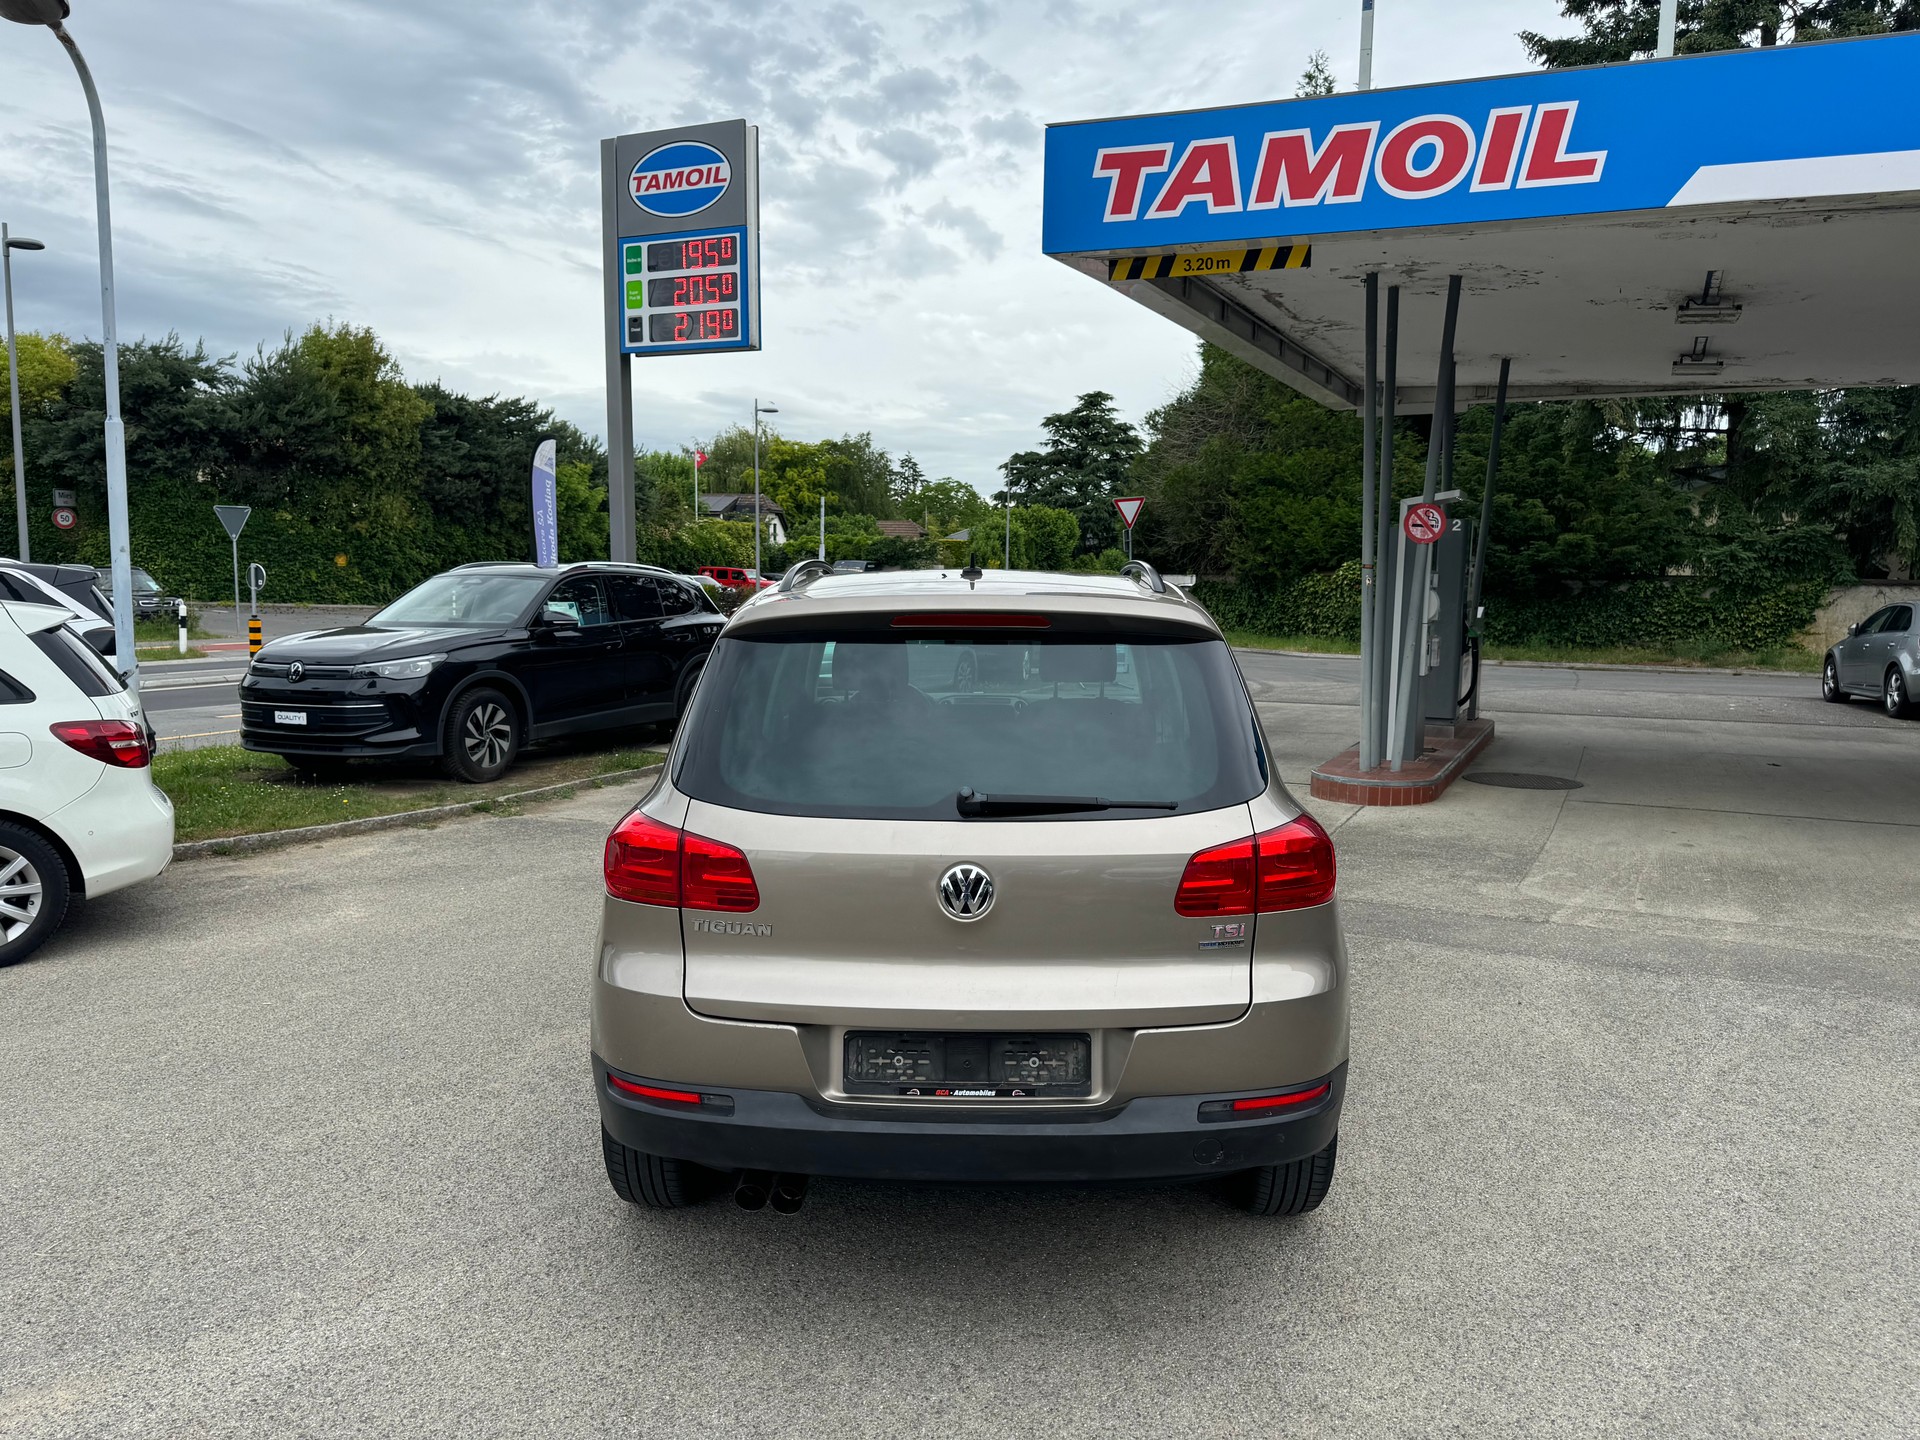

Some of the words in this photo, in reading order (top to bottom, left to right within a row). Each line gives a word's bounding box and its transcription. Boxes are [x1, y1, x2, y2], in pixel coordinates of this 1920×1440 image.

[1092, 100, 1608, 222] TAMOIL
[632, 166, 728, 193] TAMOIL
[1183, 257, 1214, 271] 3.20
[1216, 259, 1230, 269] m
[545, 479, 554, 526] Kodiaq
[60, 514, 70, 523] 50
[1452, 519, 1462, 531] 2
[692, 919, 773, 937] TIGUAN
[1210, 922, 1246, 938] TSI
